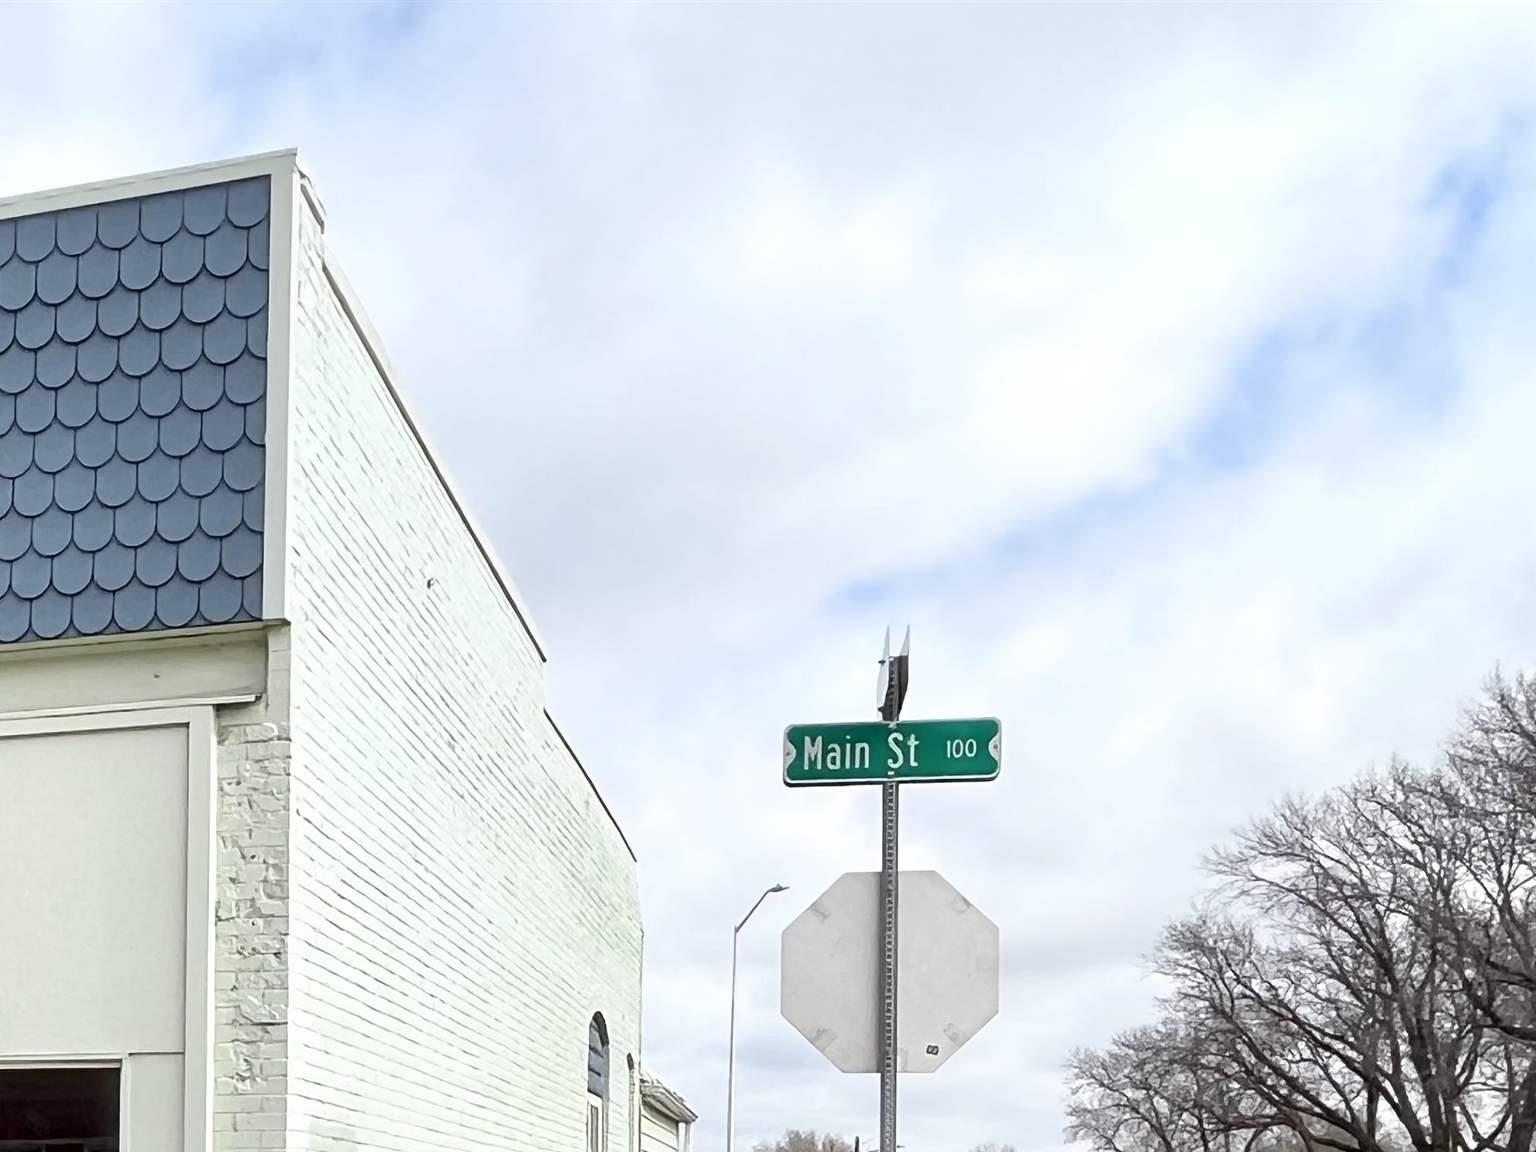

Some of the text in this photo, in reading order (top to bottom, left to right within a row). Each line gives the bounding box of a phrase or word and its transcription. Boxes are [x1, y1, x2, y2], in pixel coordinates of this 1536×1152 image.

[802, 732, 977, 770] Main St 100
